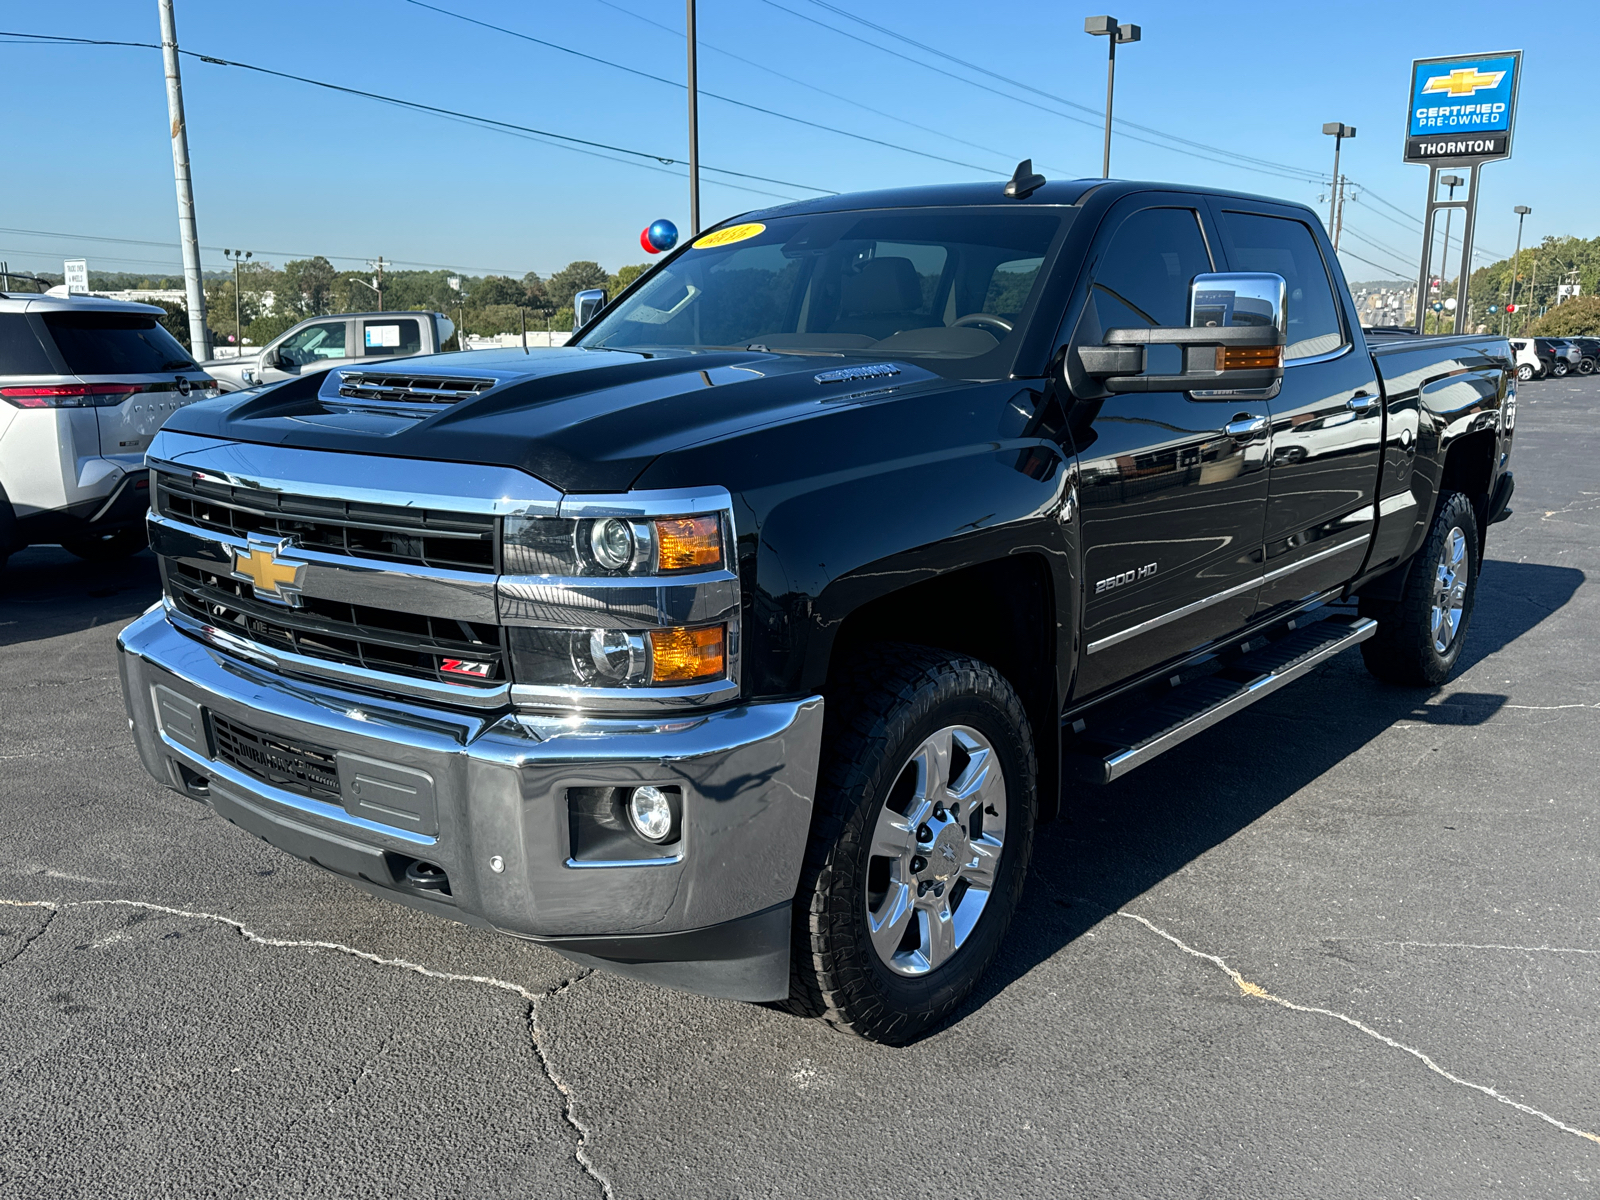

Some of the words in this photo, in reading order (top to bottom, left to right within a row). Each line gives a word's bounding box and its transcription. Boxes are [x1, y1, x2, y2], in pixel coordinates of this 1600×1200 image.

[1416, 102, 1505, 118] CERTIFIED
[1419, 113, 1500, 127] PRE-OWNED
[1419, 140, 1494, 155] THORNTON
[1095, 570, 1135, 594] 2500
[1137, 562, 1158, 580] HD
[440, 658, 489, 677] Z71
